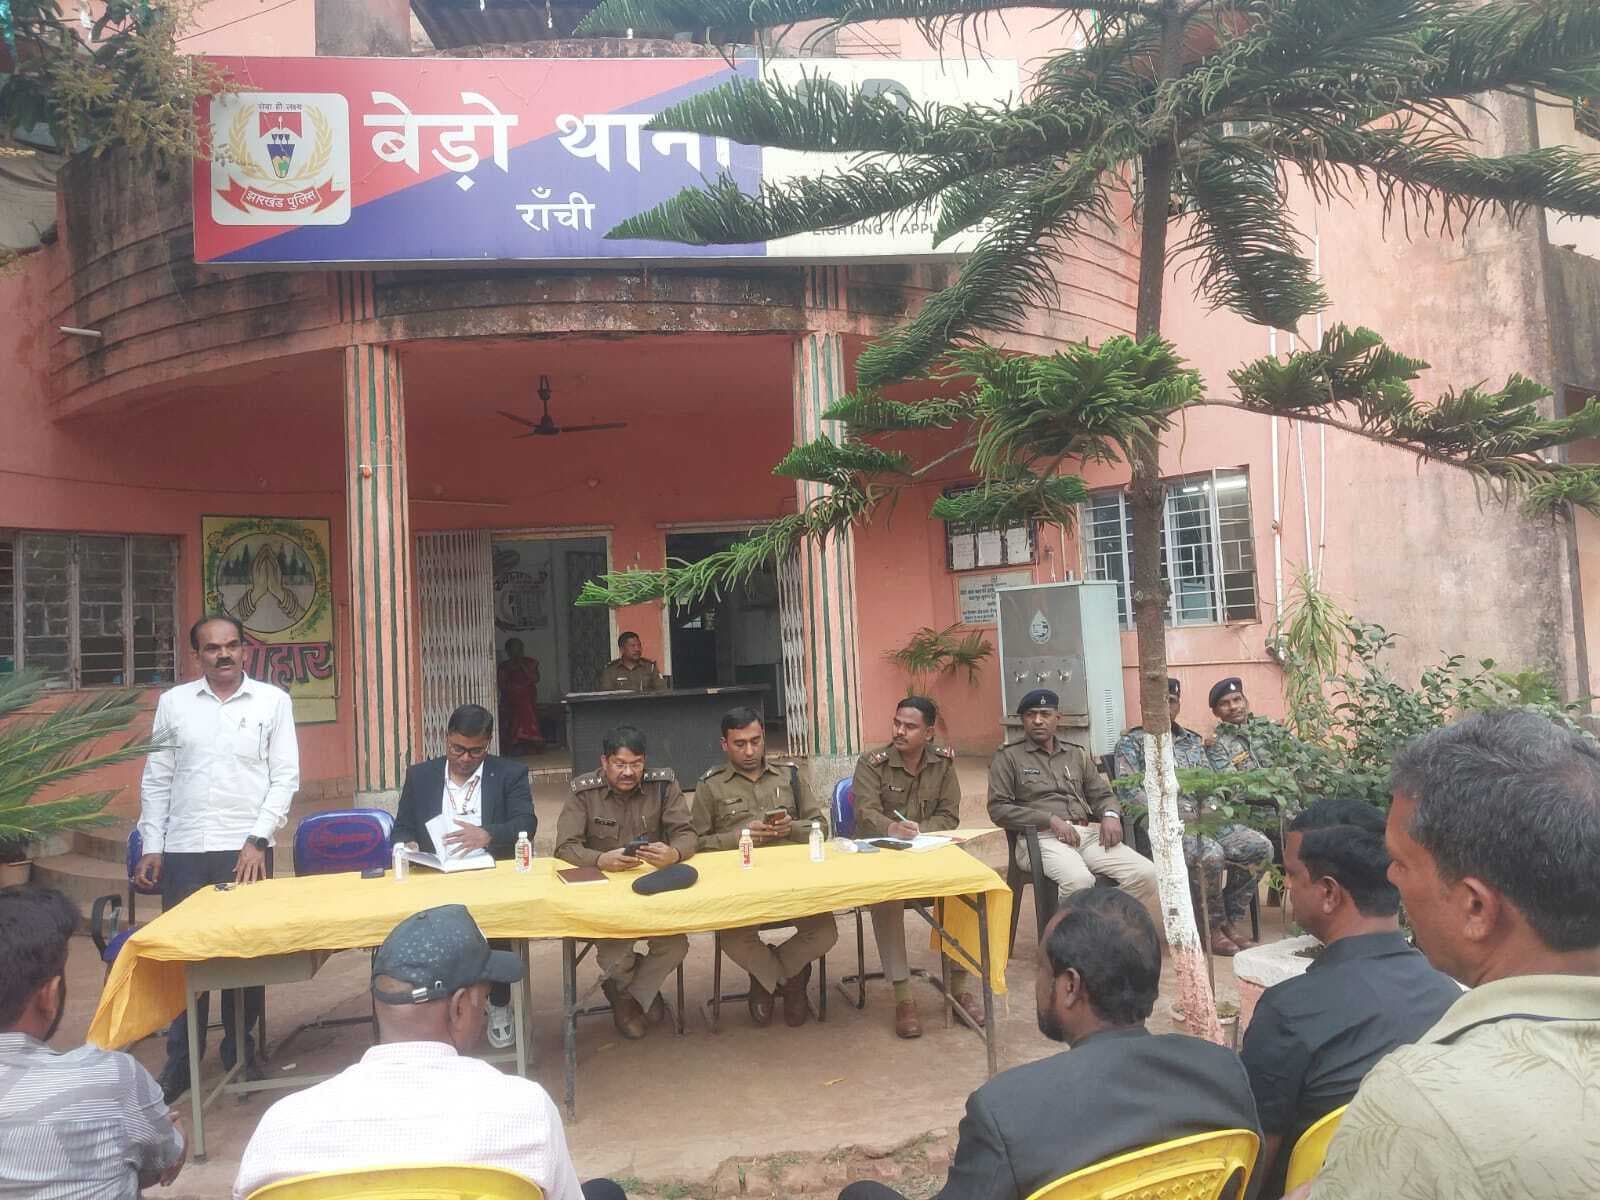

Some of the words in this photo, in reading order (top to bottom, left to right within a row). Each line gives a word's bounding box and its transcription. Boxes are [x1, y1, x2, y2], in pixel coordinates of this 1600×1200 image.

[363, 91, 519, 192] बेड़ो
[555, 113, 732, 173] थाना
[246, 190, 285, 208] झारखंड
[287, 188, 317, 210] पुलिस
[515, 186, 596, 232] राँची
[899, 222, 993, 235] APPLCES
